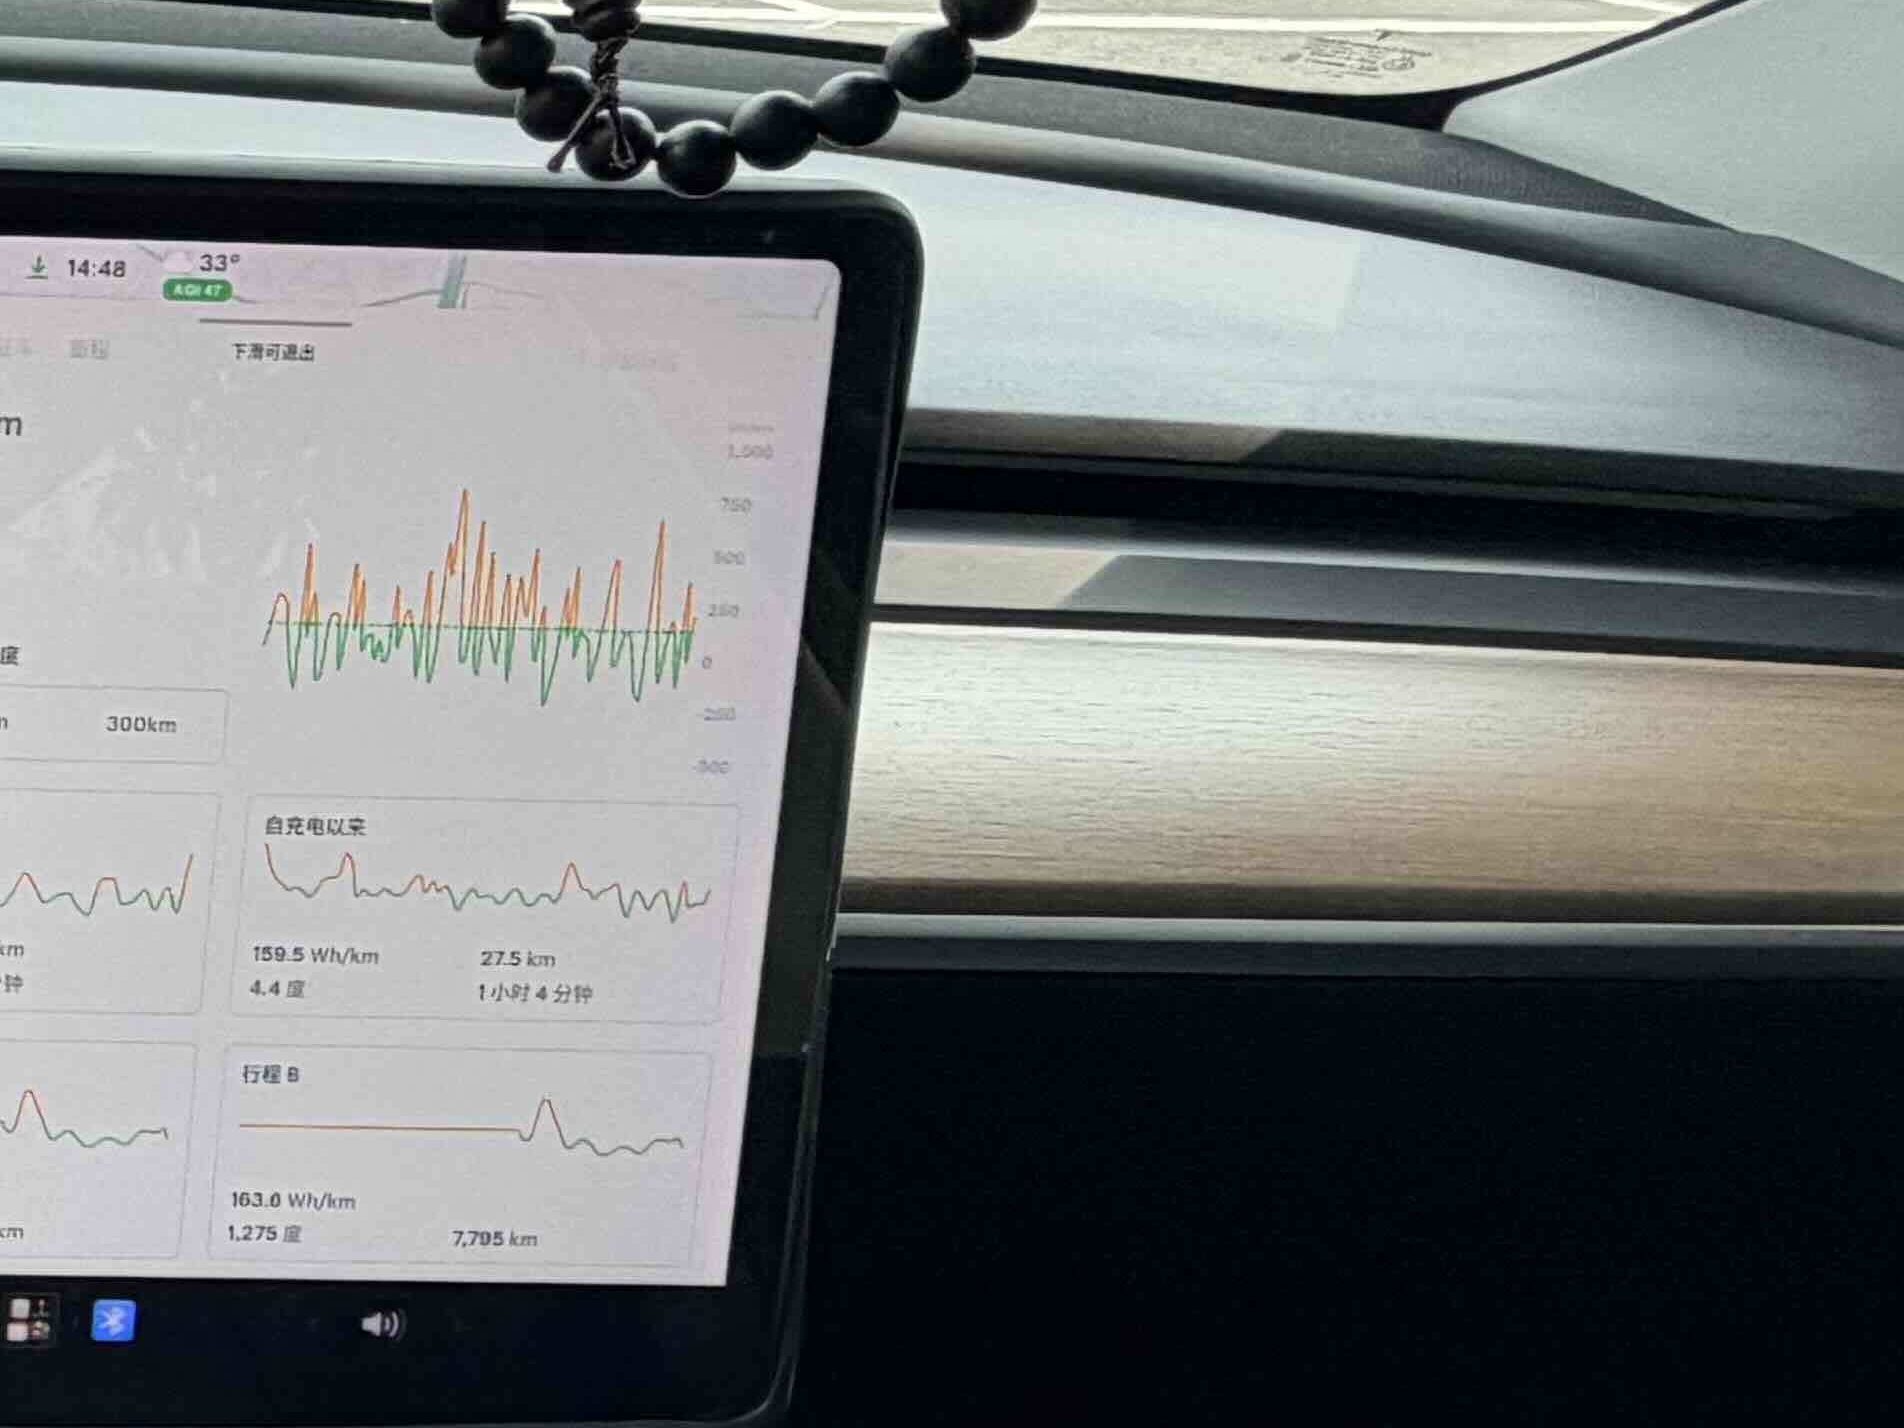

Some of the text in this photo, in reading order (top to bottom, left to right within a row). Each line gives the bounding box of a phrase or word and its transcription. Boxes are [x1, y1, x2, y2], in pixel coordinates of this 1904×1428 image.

[68, 258, 126, 278] 14:48
[199, 253, 241, 272] 33°
[106, 714, 178, 734] 300km
[265, 816, 366, 837] 自充电以来
[310, 946, 379, 967] Wh/km
[480, 950, 556, 969] 27.5 km
[250, 978, 280, 997] 4.4
[536, 984, 548, 1001] 4
[242, 1064, 282, 1084] 行程
[287, 1192, 356, 1212] Wh/km
[228, 1225, 279, 1244] 1,275
[509, 1231, 539, 1247] km
